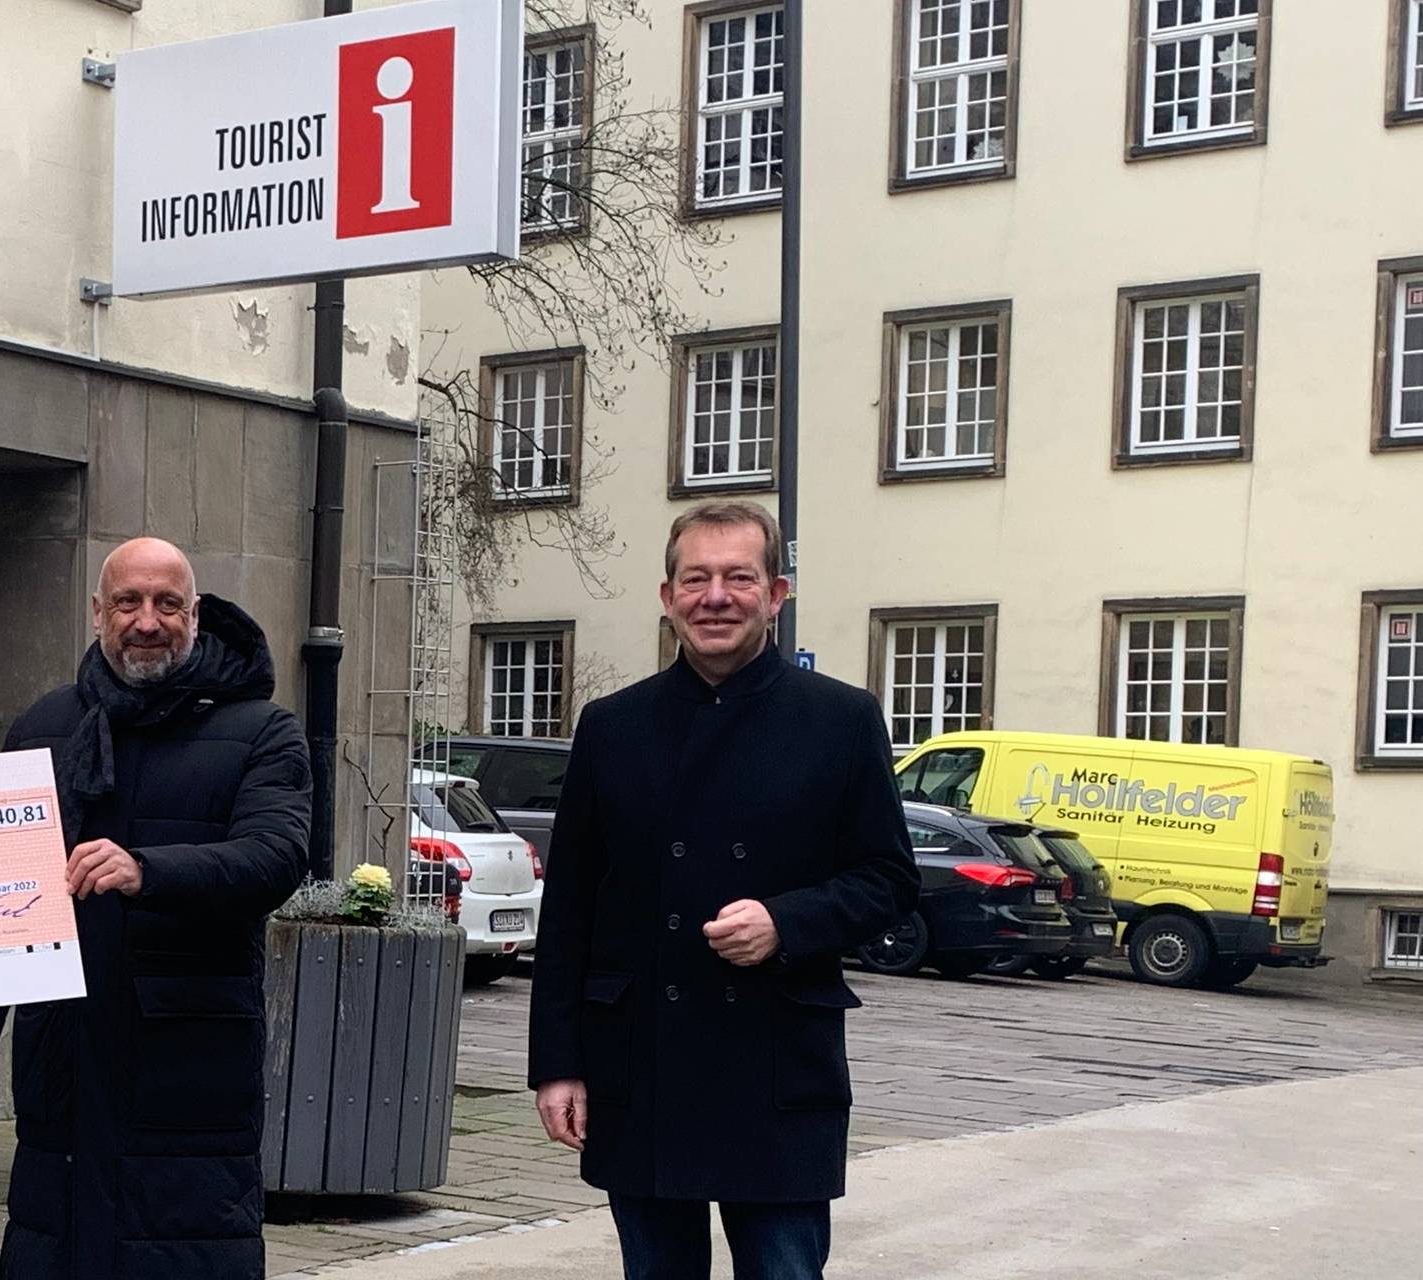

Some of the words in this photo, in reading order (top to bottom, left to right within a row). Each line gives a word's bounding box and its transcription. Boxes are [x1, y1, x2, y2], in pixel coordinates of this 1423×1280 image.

[215, 113, 327, 171] TOURIST
[141, 177, 325, 243] INFORMATION
[1071, 767, 1119, 785] Marc
[1056, 807, 1125, 825] Sanitär
[1136, 815, 1217, 835] Heizung
[13, 880, 38, 891] 2022
